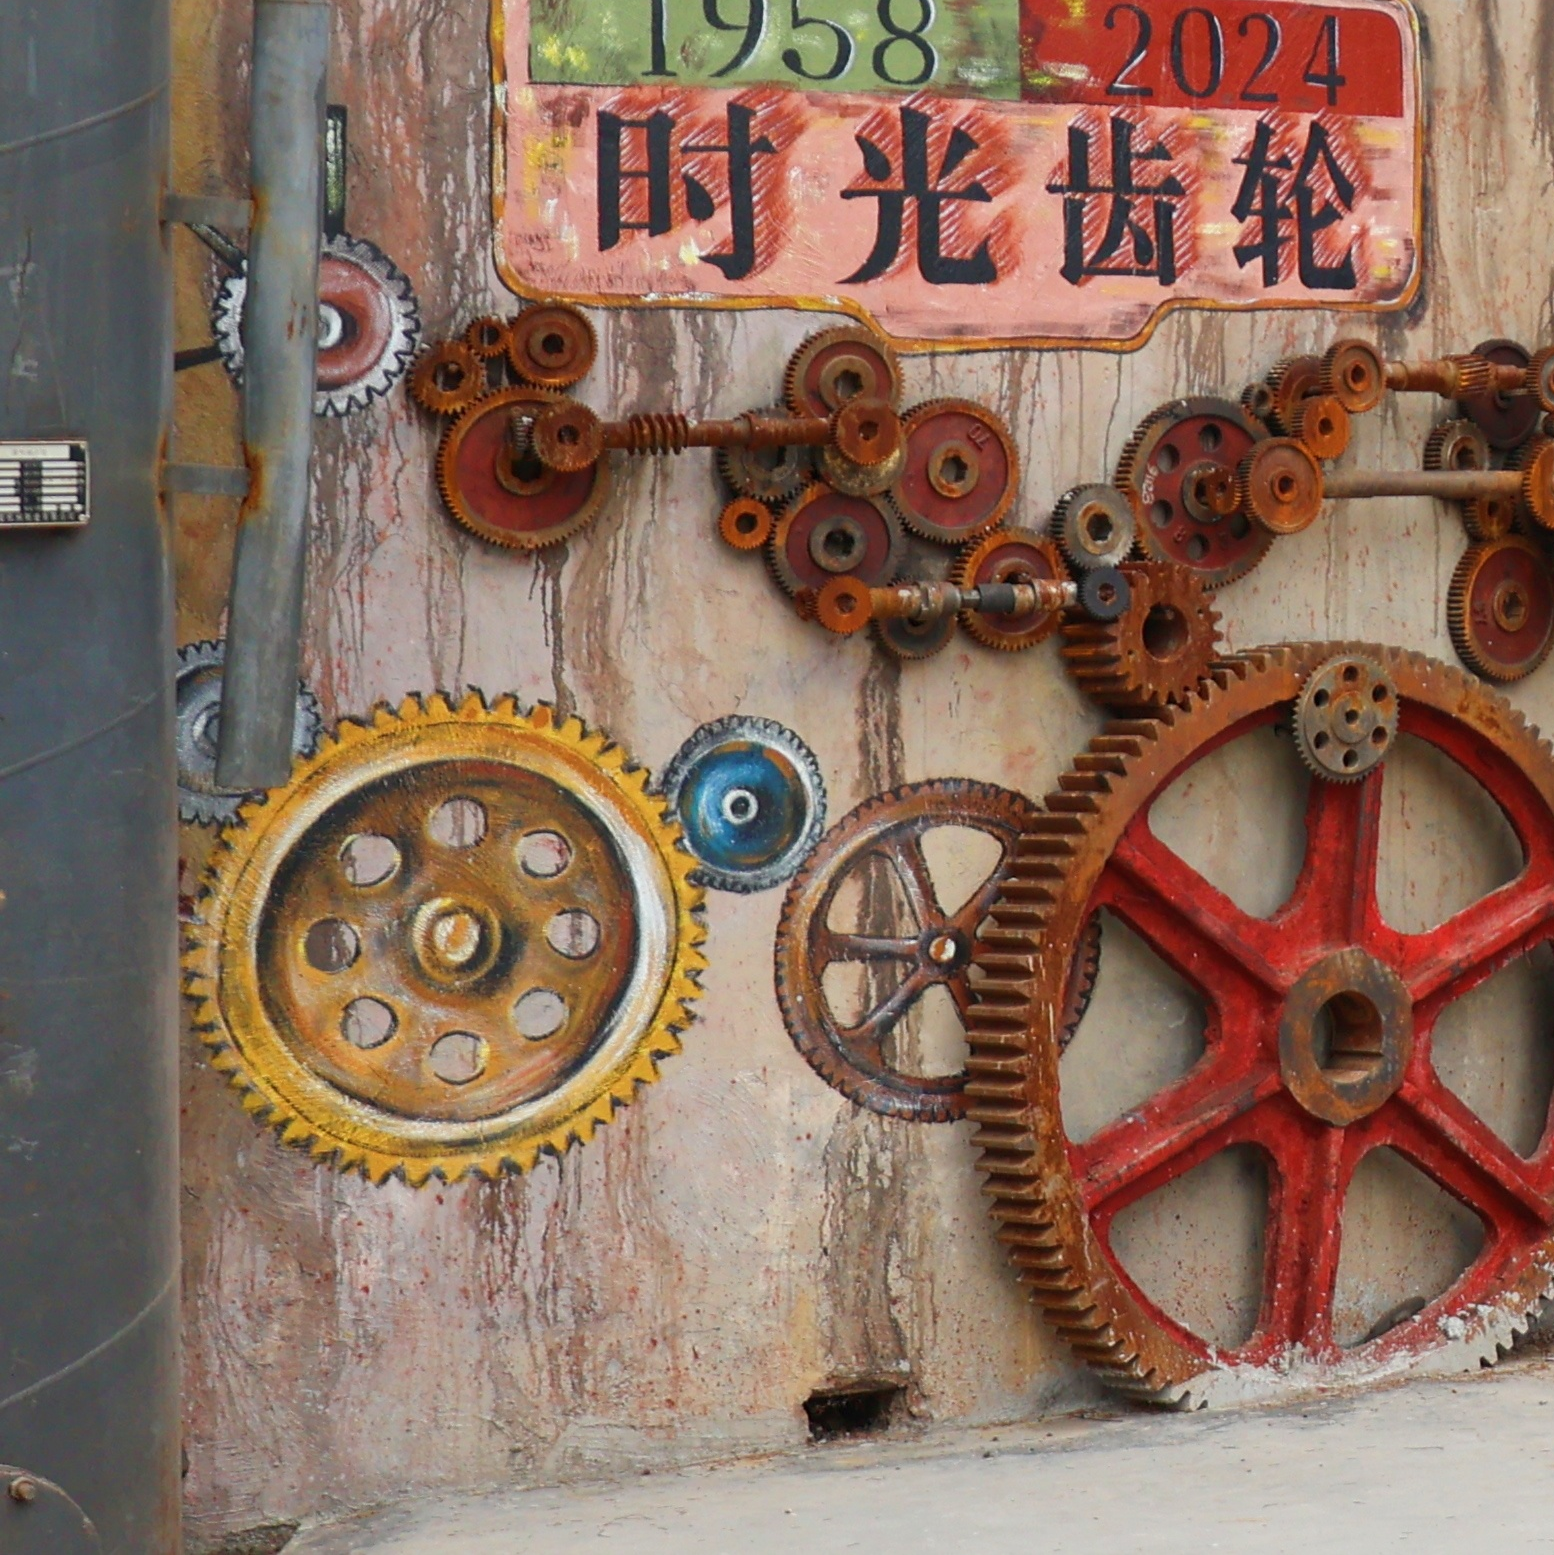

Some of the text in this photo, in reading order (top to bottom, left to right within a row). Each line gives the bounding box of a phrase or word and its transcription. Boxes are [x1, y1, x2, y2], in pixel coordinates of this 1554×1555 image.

[1104, 3, 1346, 107] 2024
[597, 104, 1358, 290] 时光齿轮
